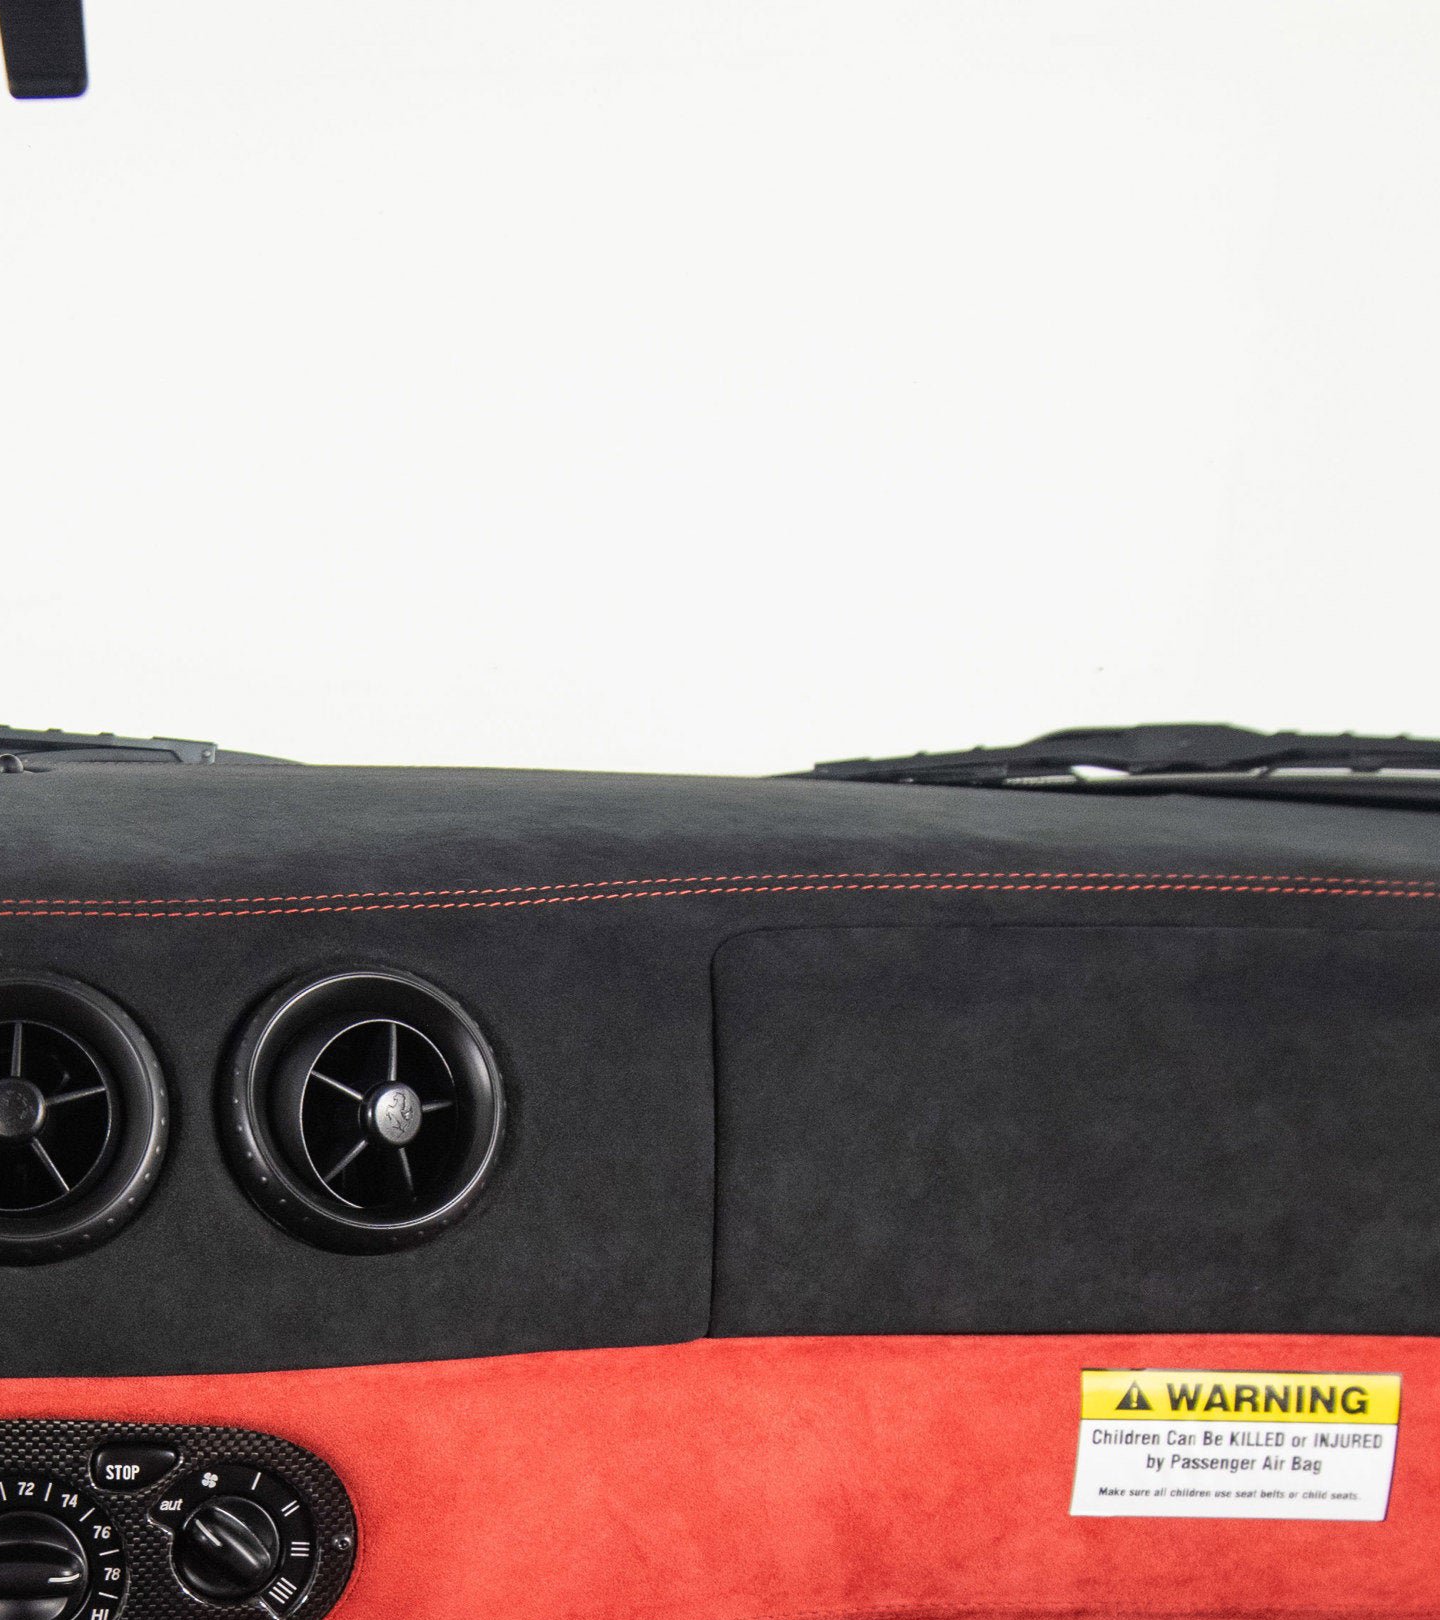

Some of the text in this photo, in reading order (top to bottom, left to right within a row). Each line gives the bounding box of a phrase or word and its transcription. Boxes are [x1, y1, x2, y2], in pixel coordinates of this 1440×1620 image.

[1166, 1382, 1370, 1415] WARNING
[1091, 1428, 1384, 1450] Children Can Be KILLED or INJURED
[1145, 1453, 1323, 1476] by Passenger Air Bag
[105, 1464, 141, 1481] STOP
[17, 1481, 36, 1496] 72
[1098, 1486, 1126, 1497] Make
[1129, 1488, 1151, 1497] sure
[1154, 1486, 1167, 1497] all
[1170, 1487, 1212, 1498] children
[1214, 1490, 1232, 1498] use
[1235, 1489, 1257, 1498] seat
[1260, 1489, 1285, 1499] belts
[1288, 1491, 1300, 1499] or
[1302, 1490, 1327, 1500] child
[61, 1493, 79, 1509] 74
[159, 1498, 184, 1512] aut
[92, 1525, 112, 1540] 76
[103, 1567, 121, 1581] 78
